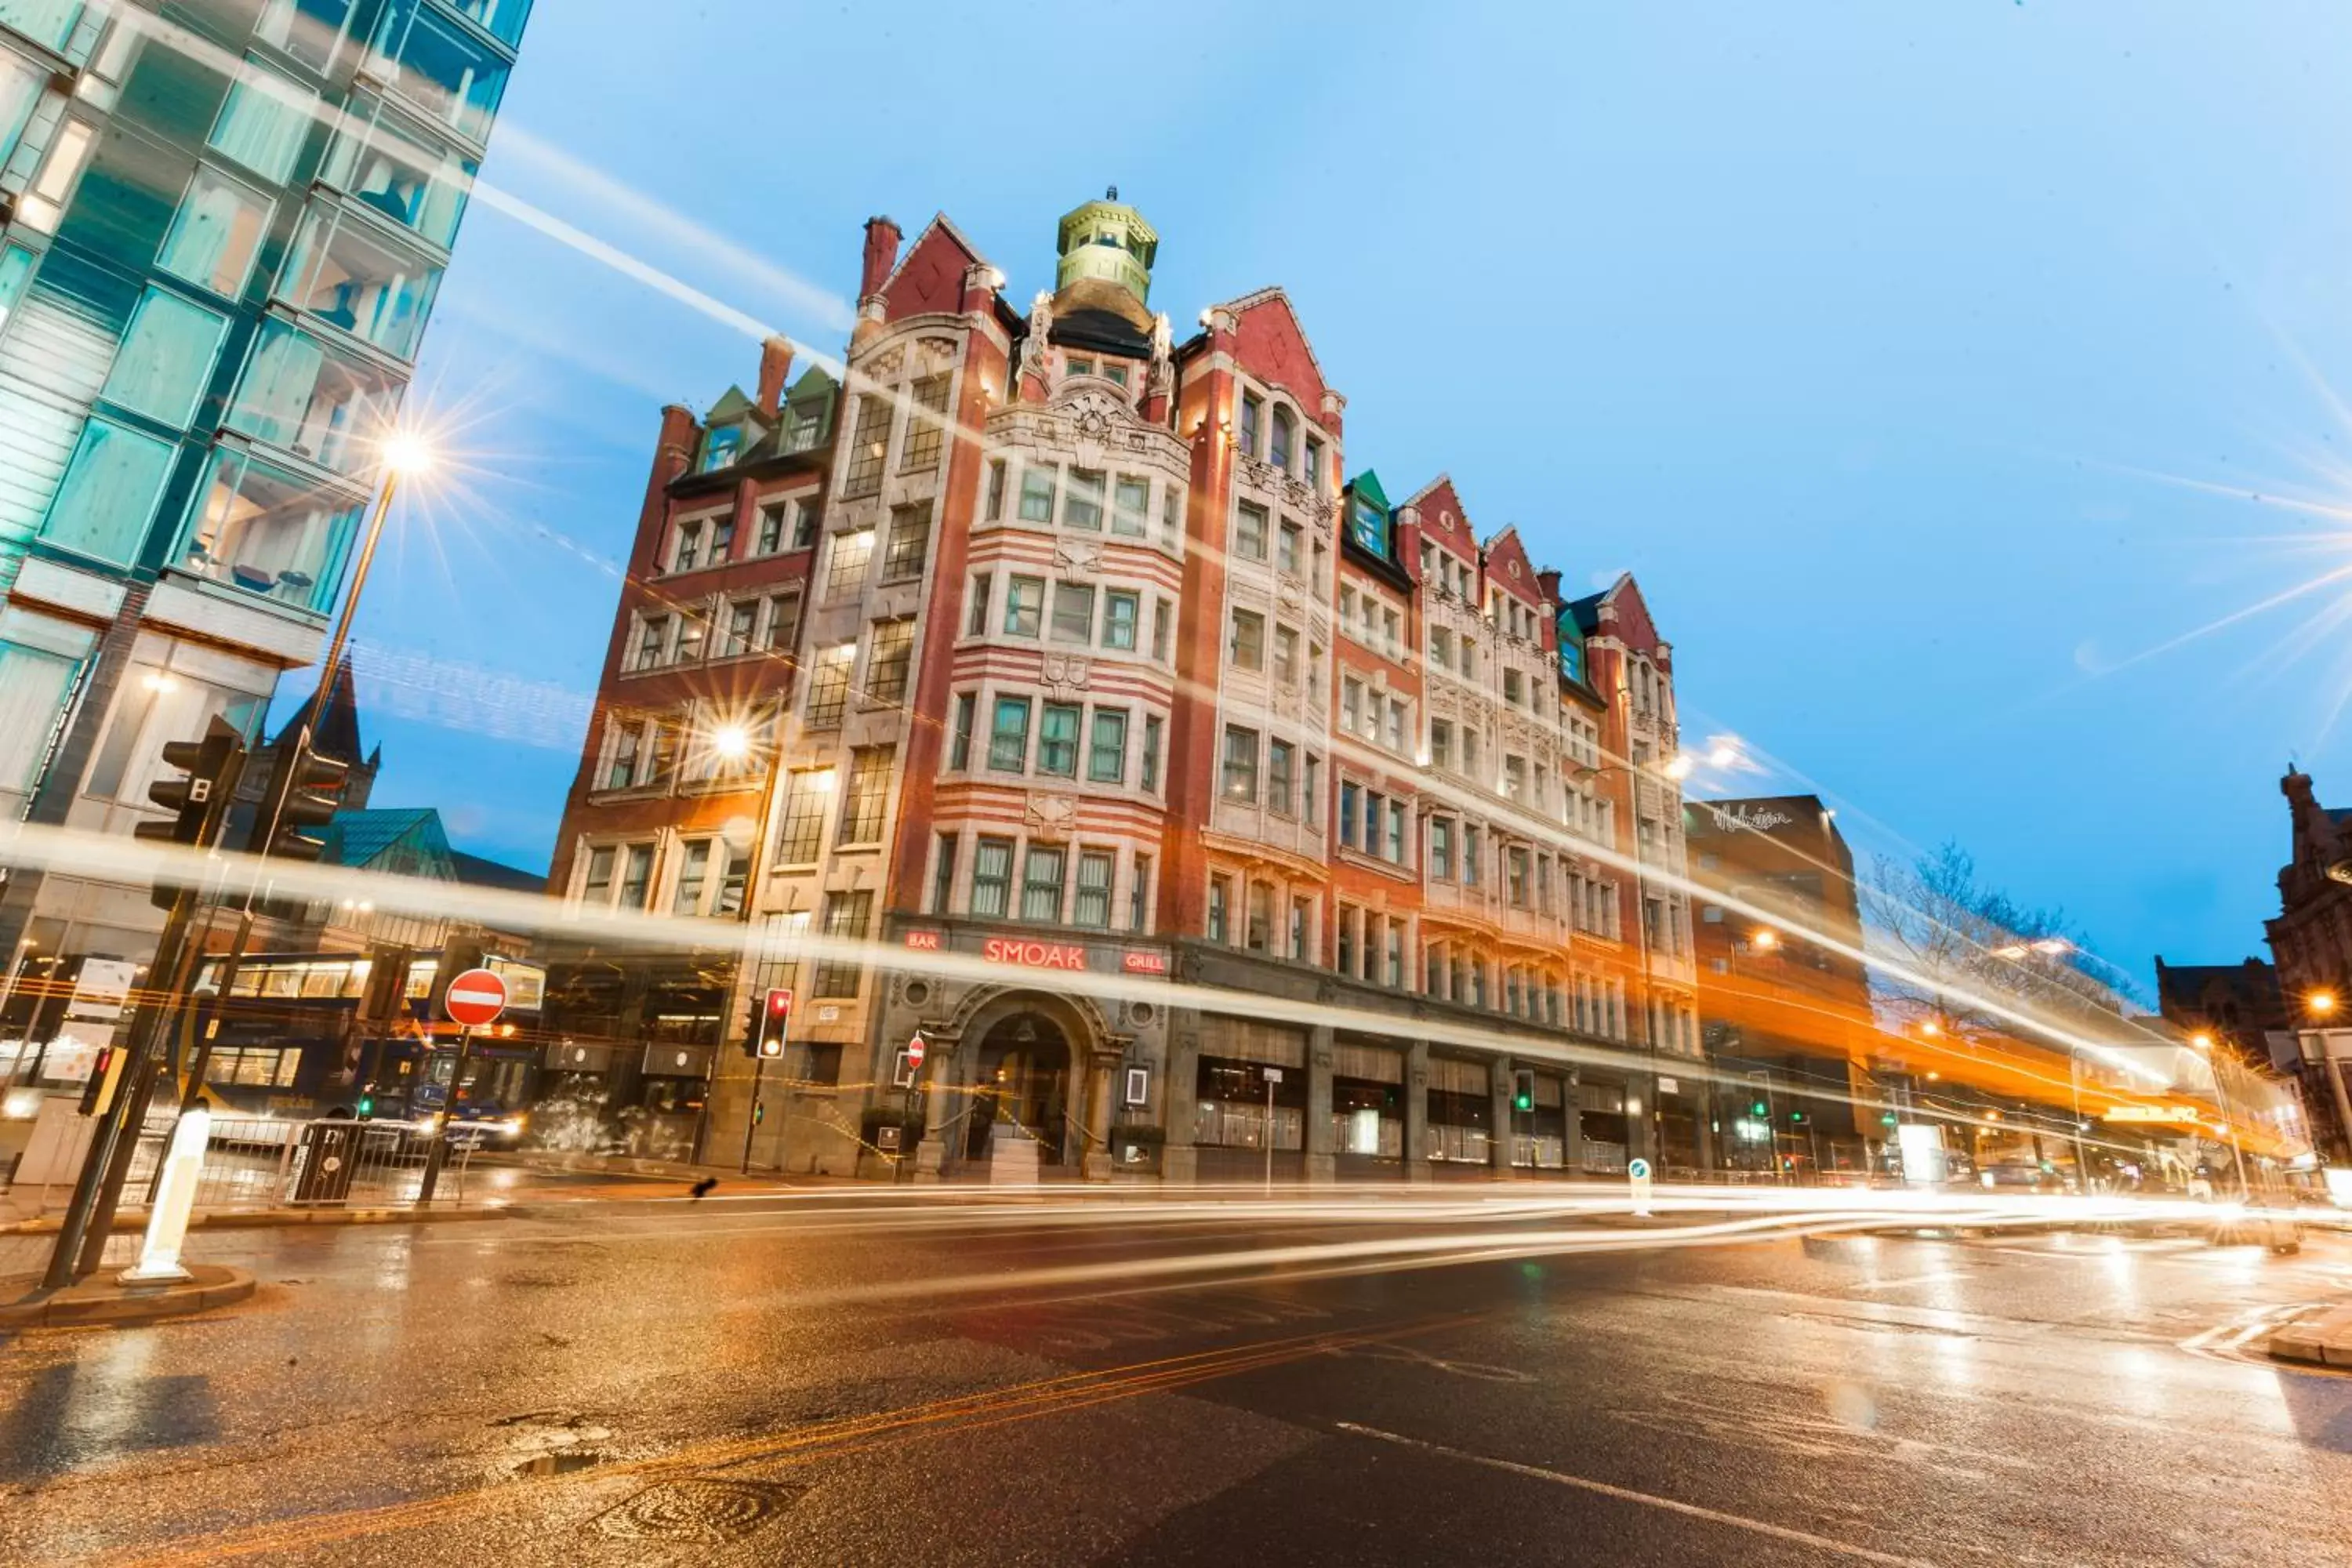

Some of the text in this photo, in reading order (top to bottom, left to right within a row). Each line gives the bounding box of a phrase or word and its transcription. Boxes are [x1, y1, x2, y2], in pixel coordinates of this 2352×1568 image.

[909, 933, 937, 949] BAR
[987, 939, 1085, 970] SMOAK
[1126, 955, 1164, 971] GRILL
